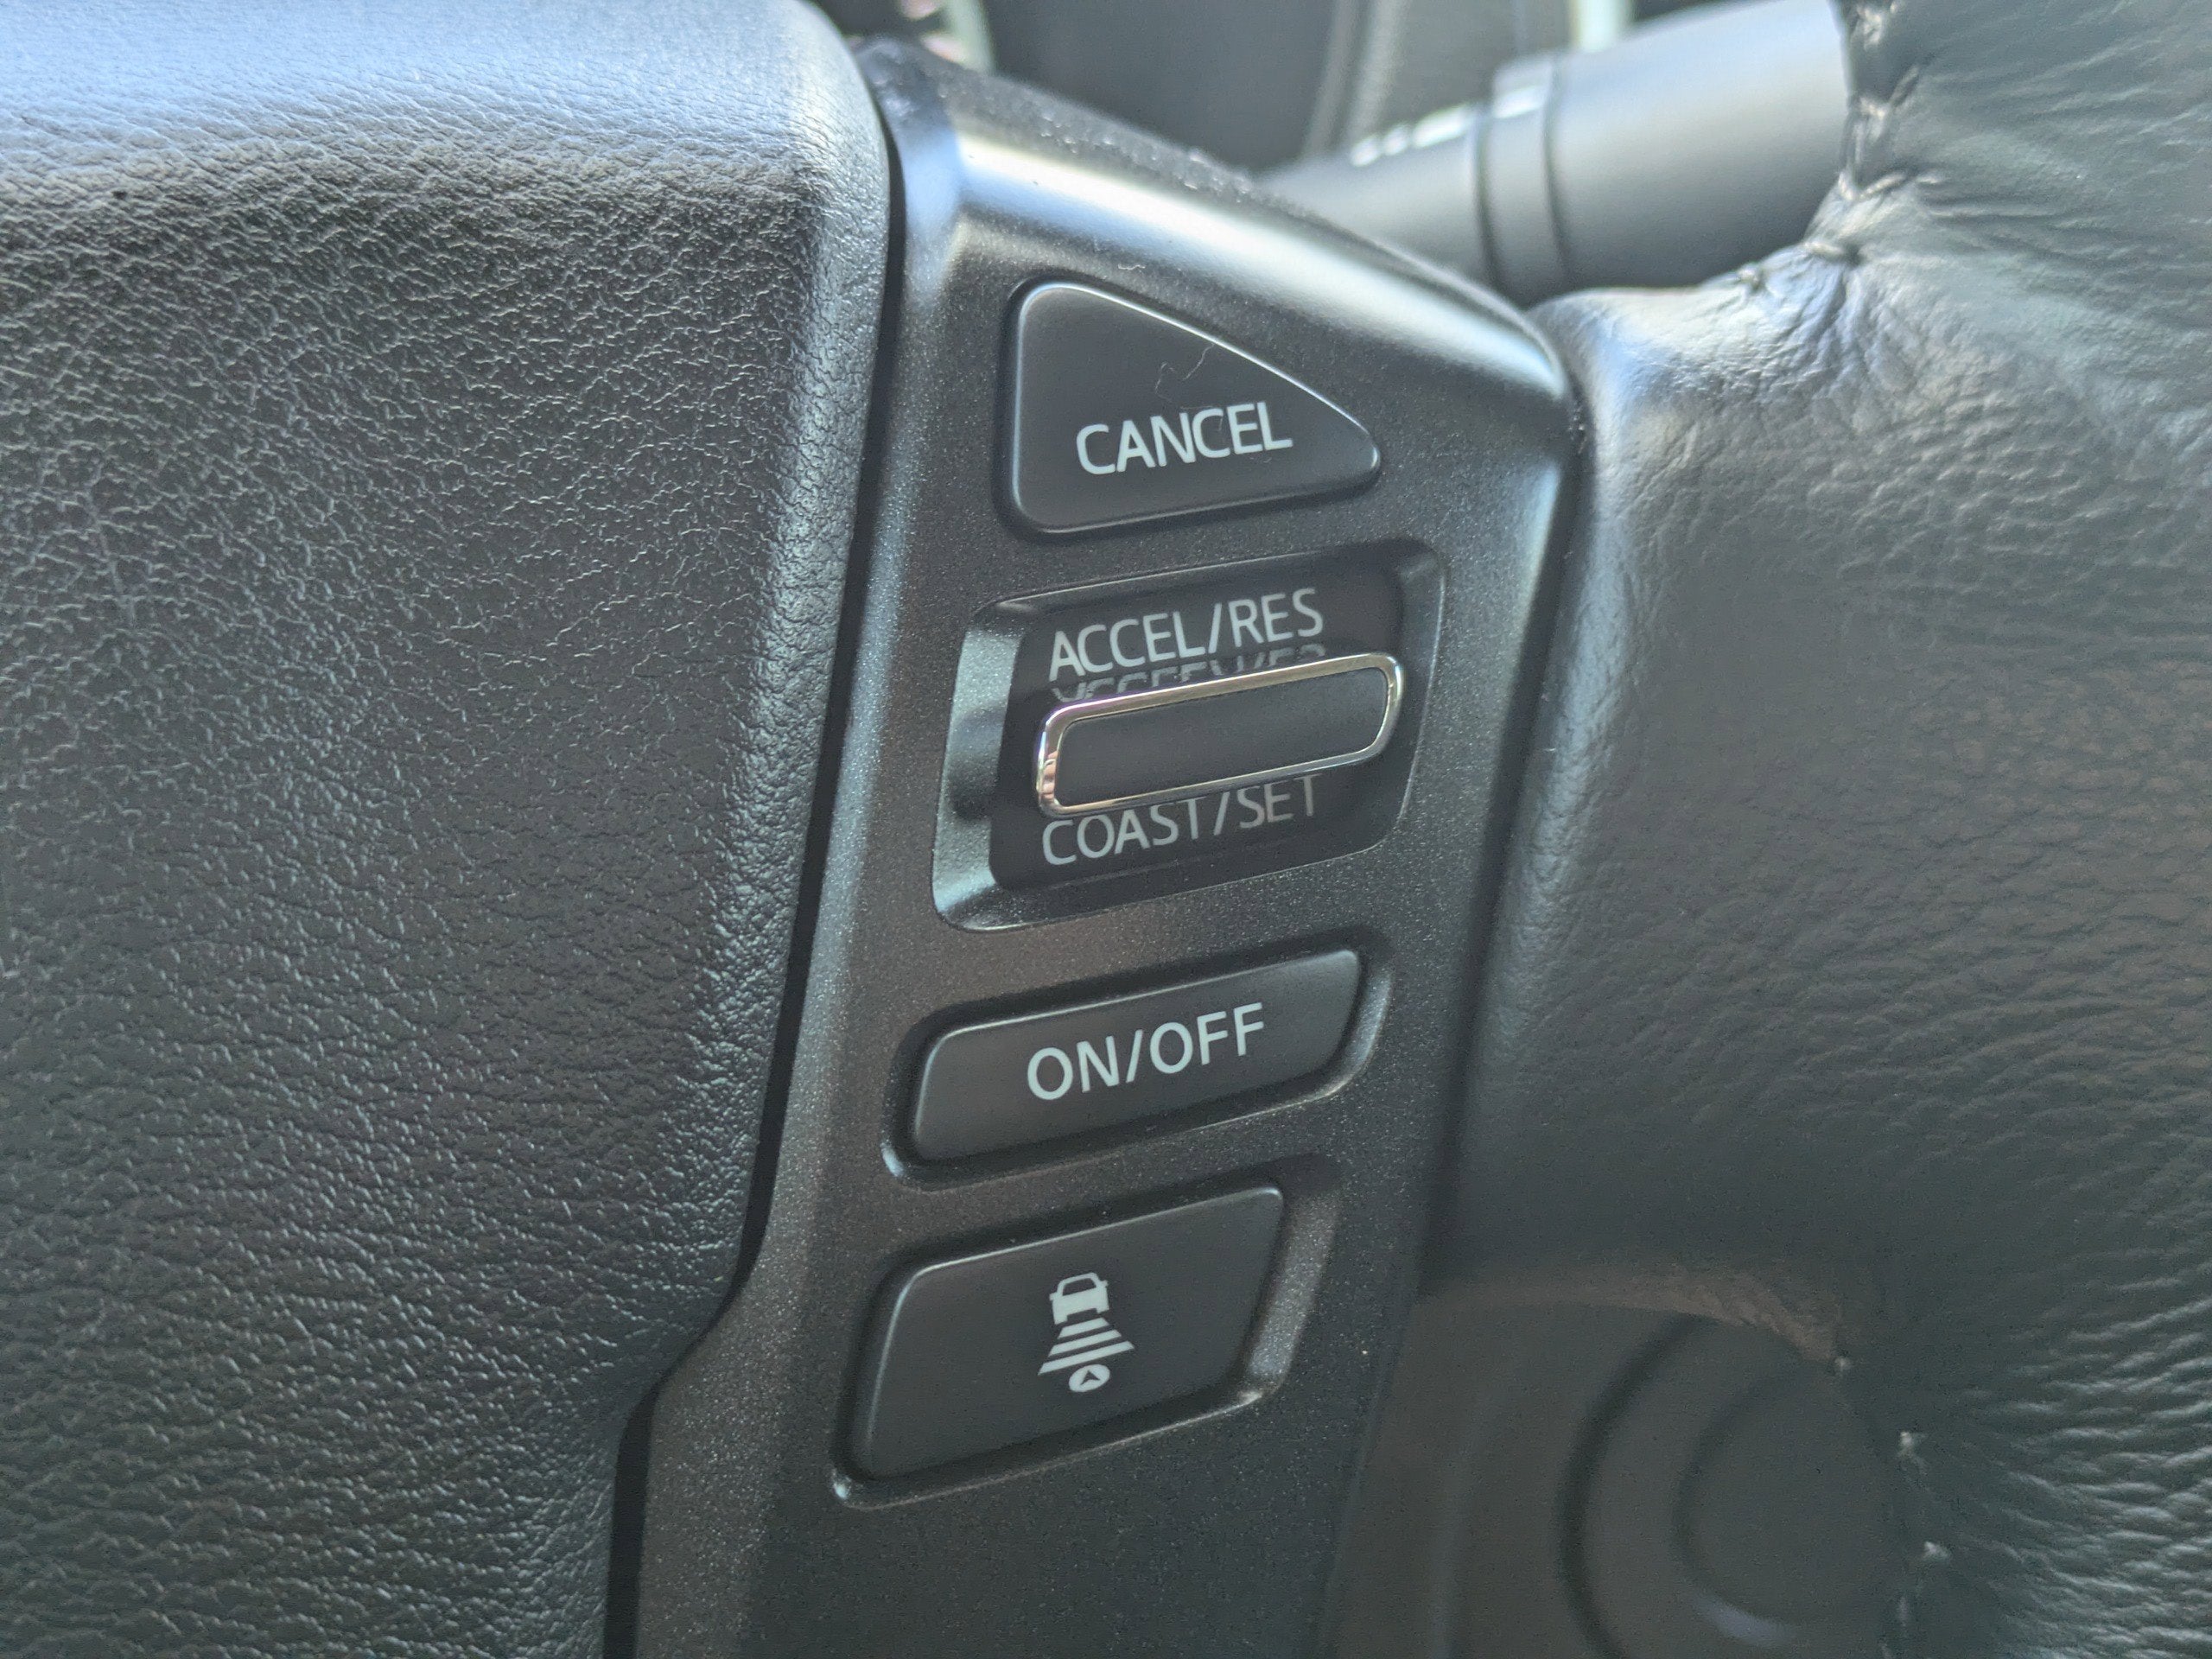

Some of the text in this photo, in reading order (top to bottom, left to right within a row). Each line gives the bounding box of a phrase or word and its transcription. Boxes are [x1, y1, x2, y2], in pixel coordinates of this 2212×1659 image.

[1075, 401, 1294, 475] CANCEL
[1047, 588, 1324, 682] ACCEL/RES
[1042, 774, 1323, 866] COAST/SET
[1027, 1001, 1265, 1101] ON/OFF
